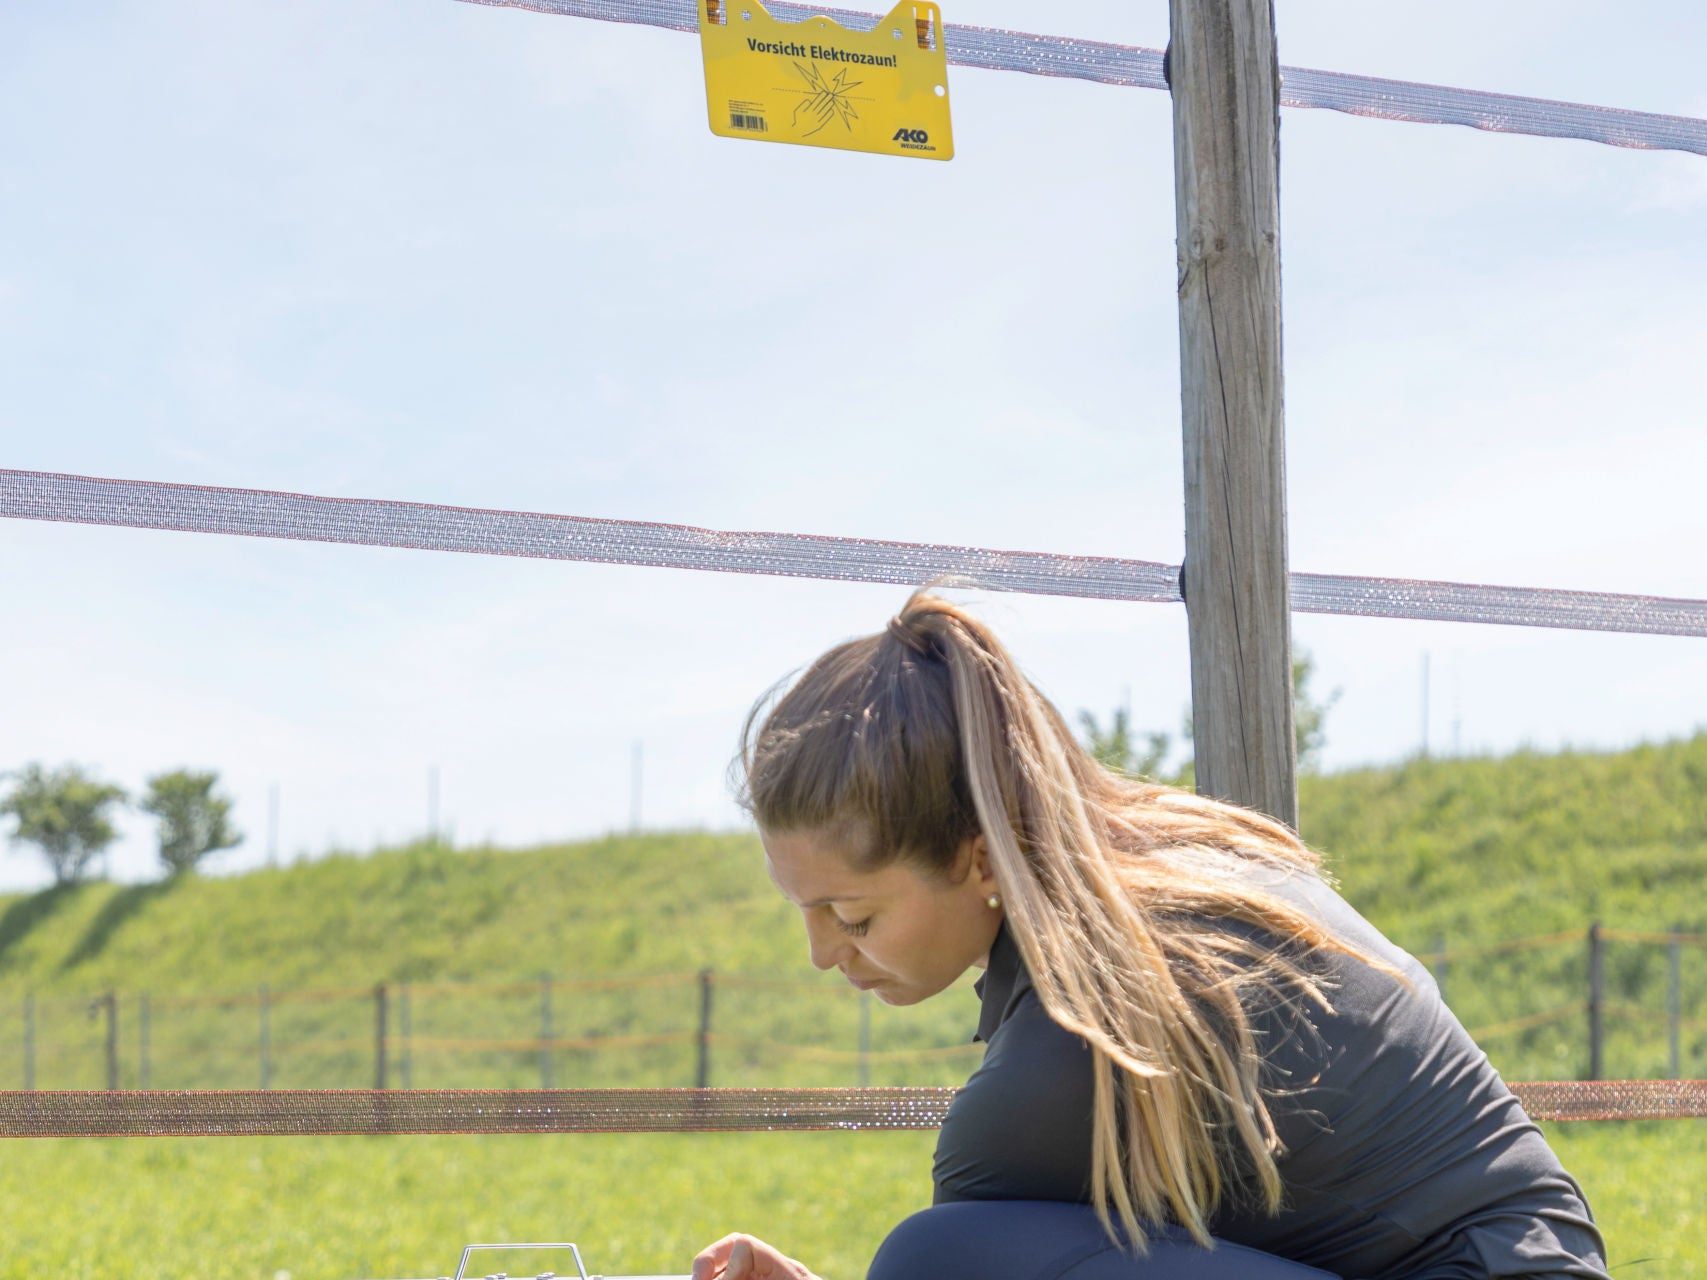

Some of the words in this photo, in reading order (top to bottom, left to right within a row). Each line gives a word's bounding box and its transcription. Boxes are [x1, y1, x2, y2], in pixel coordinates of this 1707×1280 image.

[747, 38, 806, 58] Vorsicht
[810, 46, 897, 68] Elektrozaun!
[892, 128, 928, 144] AKO
